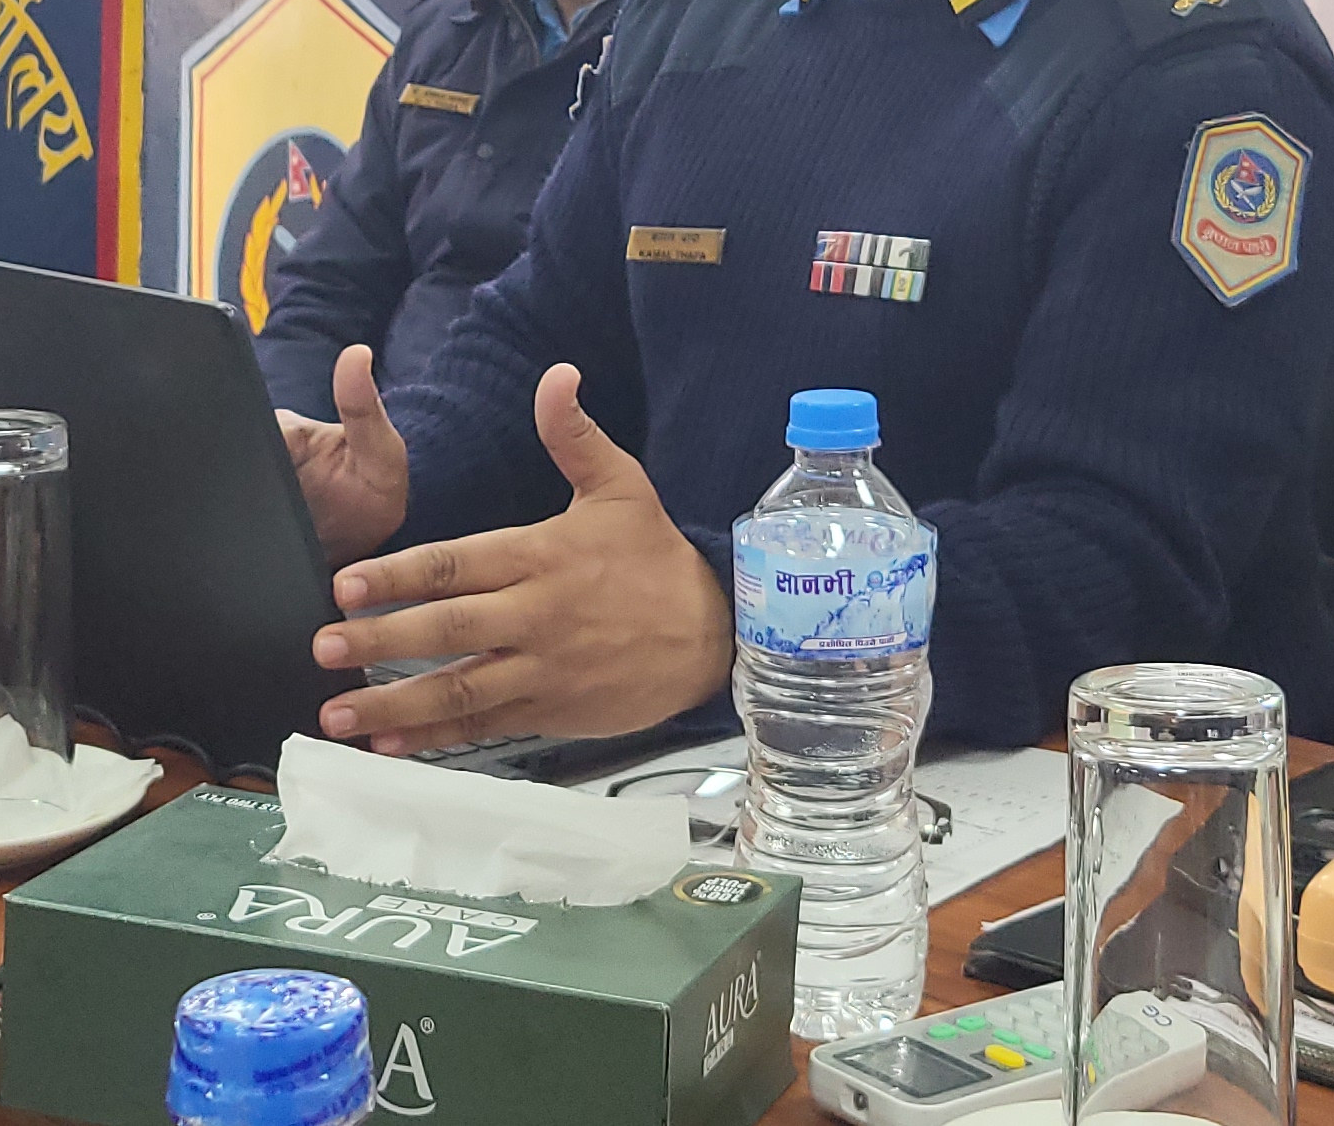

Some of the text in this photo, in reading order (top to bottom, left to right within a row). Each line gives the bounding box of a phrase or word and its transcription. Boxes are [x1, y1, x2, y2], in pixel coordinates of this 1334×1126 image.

[196, 792, 226, 803] PLY
[225, 797, 256, 809] TWO
[698, 882, 745, 895] VIRGIN
[705, 876, 752, 888] PULP
[691, 888, 741, 902] 100%
[378, 895, 518, 929] CARE
[228, 884, 523, 957] AURA
[703, 960, 759, 1055] AURA
